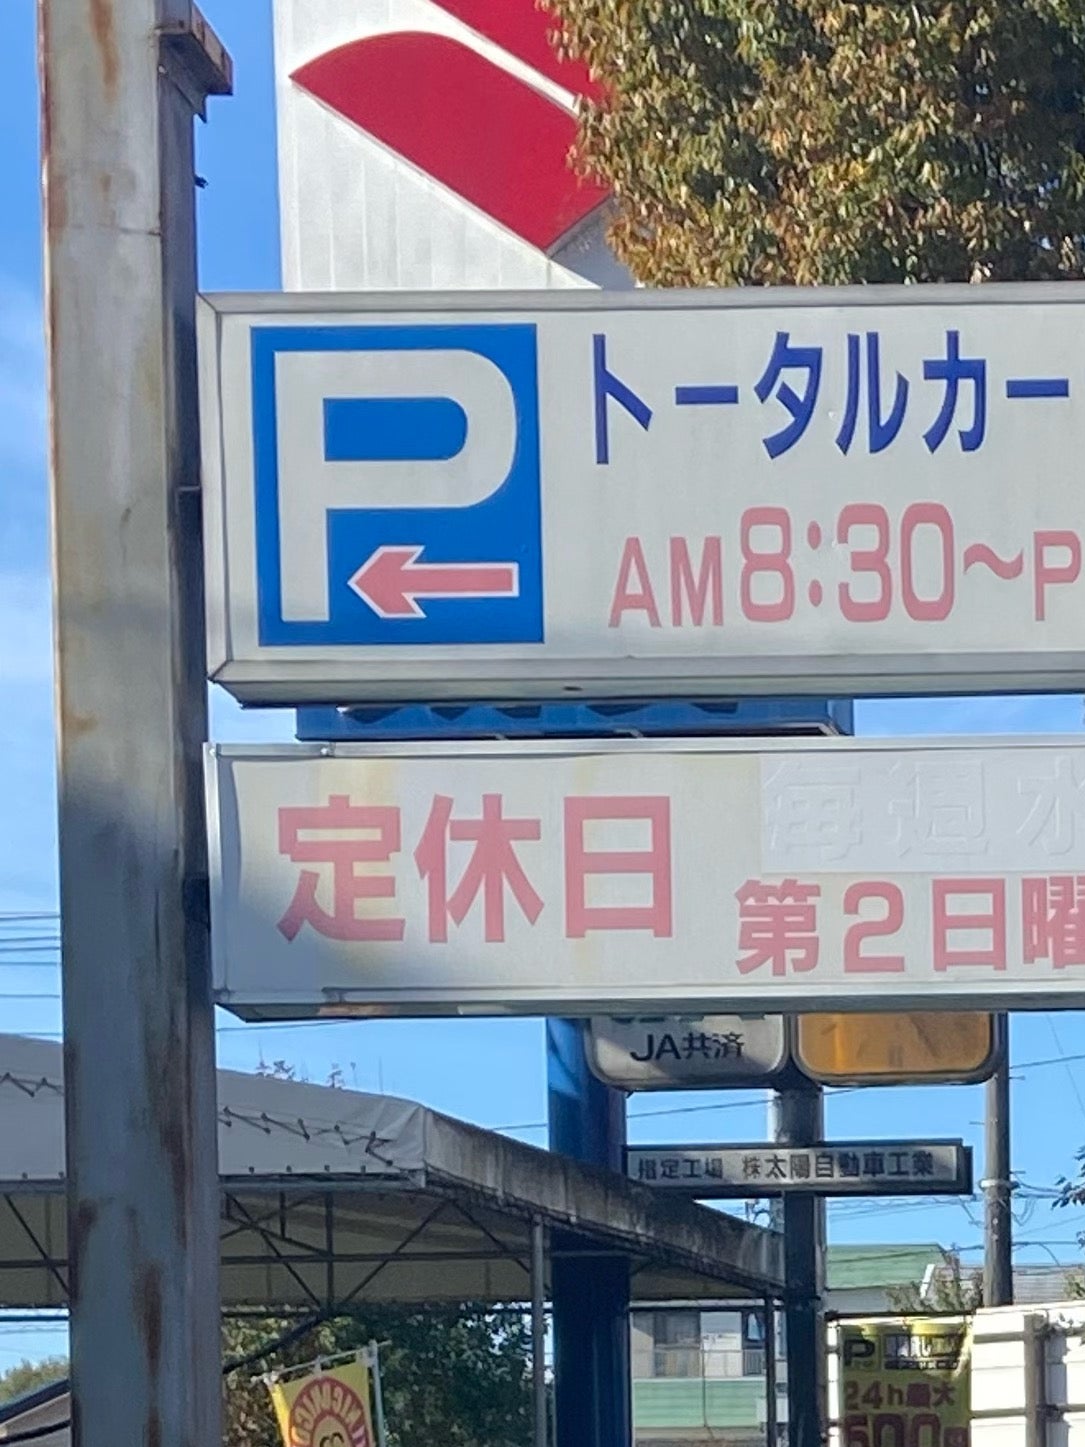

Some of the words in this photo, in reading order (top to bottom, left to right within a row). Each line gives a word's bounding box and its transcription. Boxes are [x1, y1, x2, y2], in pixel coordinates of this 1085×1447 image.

[274, 348, 518, 624] P
[276, 793, 673, 944] 定休日
[630, 1031, 744, 1062] JA共済
